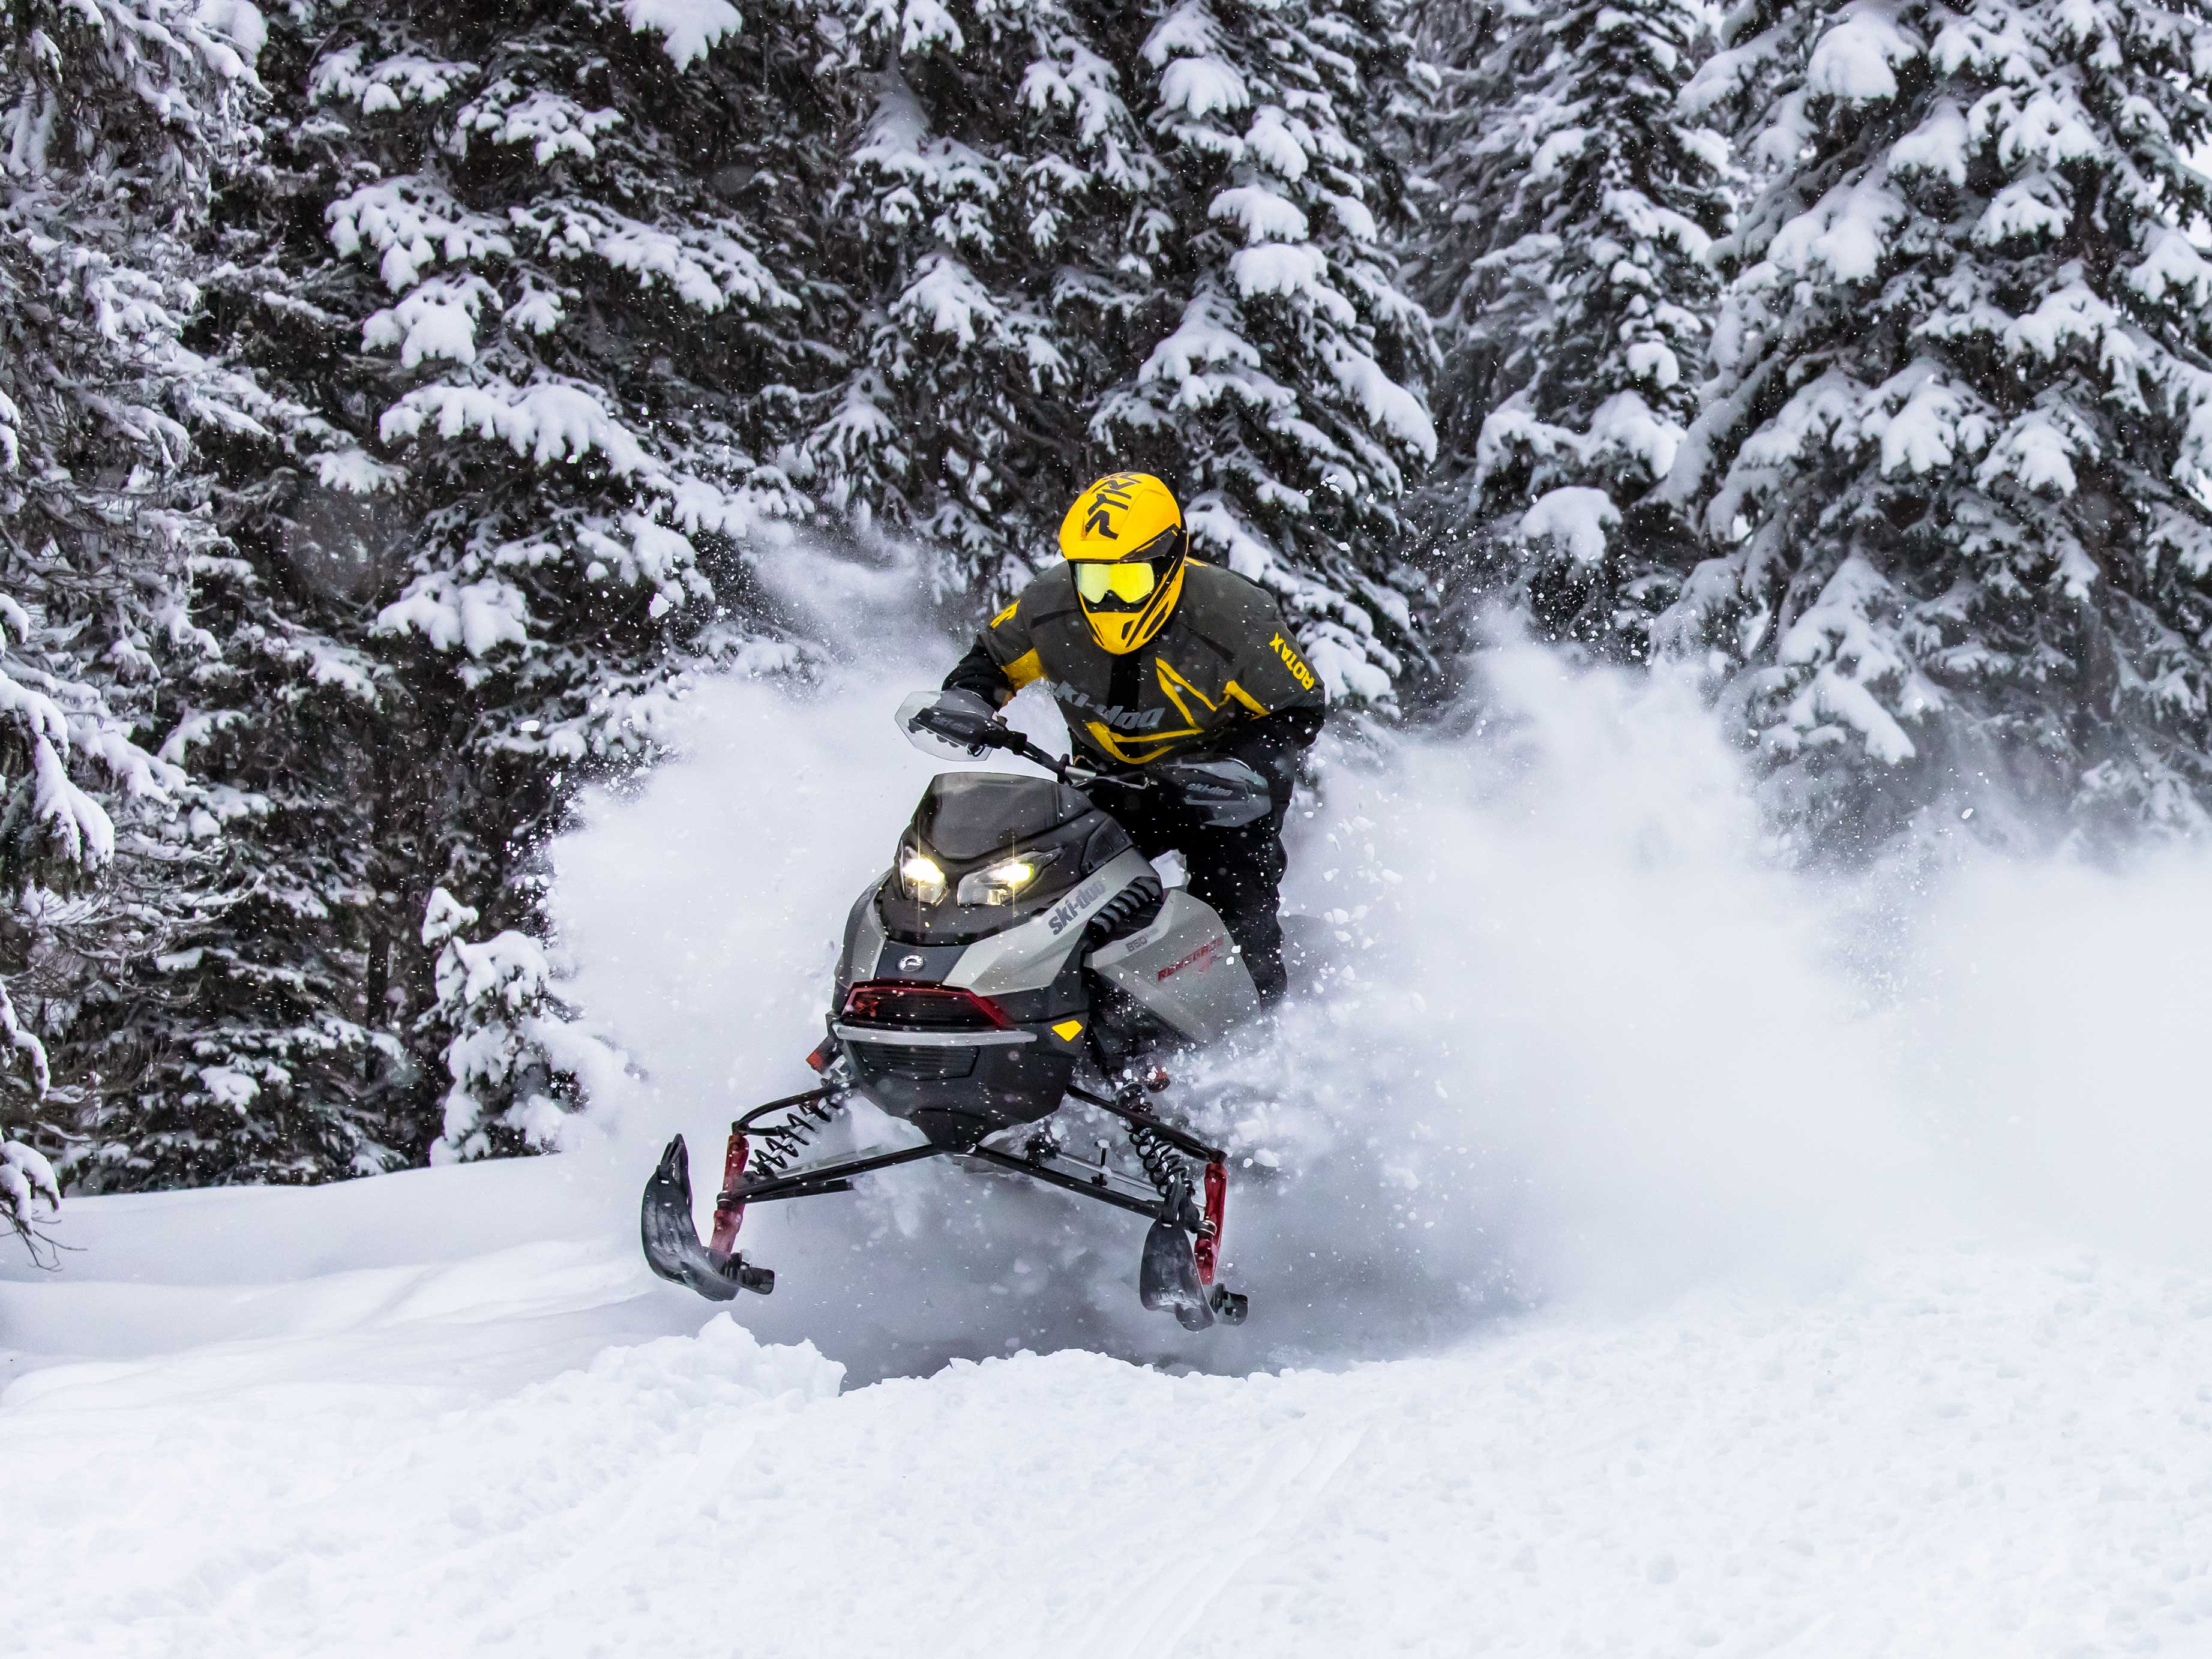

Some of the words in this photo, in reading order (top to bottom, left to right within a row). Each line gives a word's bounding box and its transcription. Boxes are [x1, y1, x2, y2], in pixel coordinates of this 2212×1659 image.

[1269, 631, 1315, 691] ROTAX
[1050, 679, 1166, 730] ki-doo
[1048, 880, 1105, 935] ski-doo
